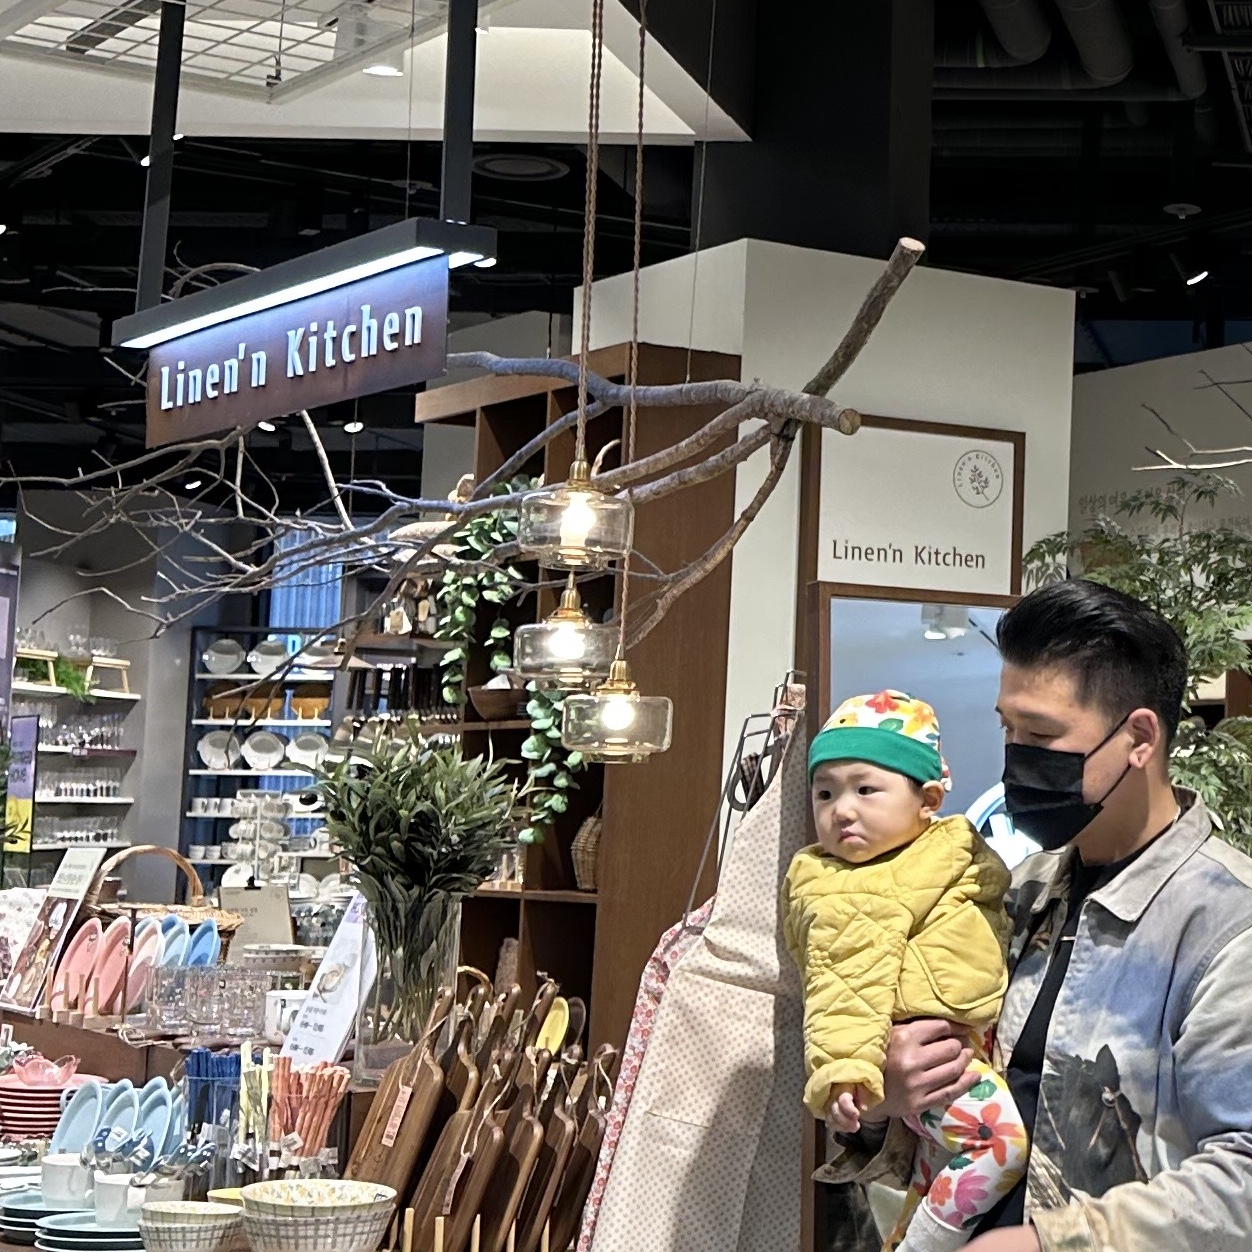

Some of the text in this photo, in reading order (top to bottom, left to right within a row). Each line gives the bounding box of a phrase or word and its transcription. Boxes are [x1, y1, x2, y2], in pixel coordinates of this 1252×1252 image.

[159, 304, 424, 411] Linen'n Kitchen
[832, 539, 986, 569] Linen'n Kitchen
